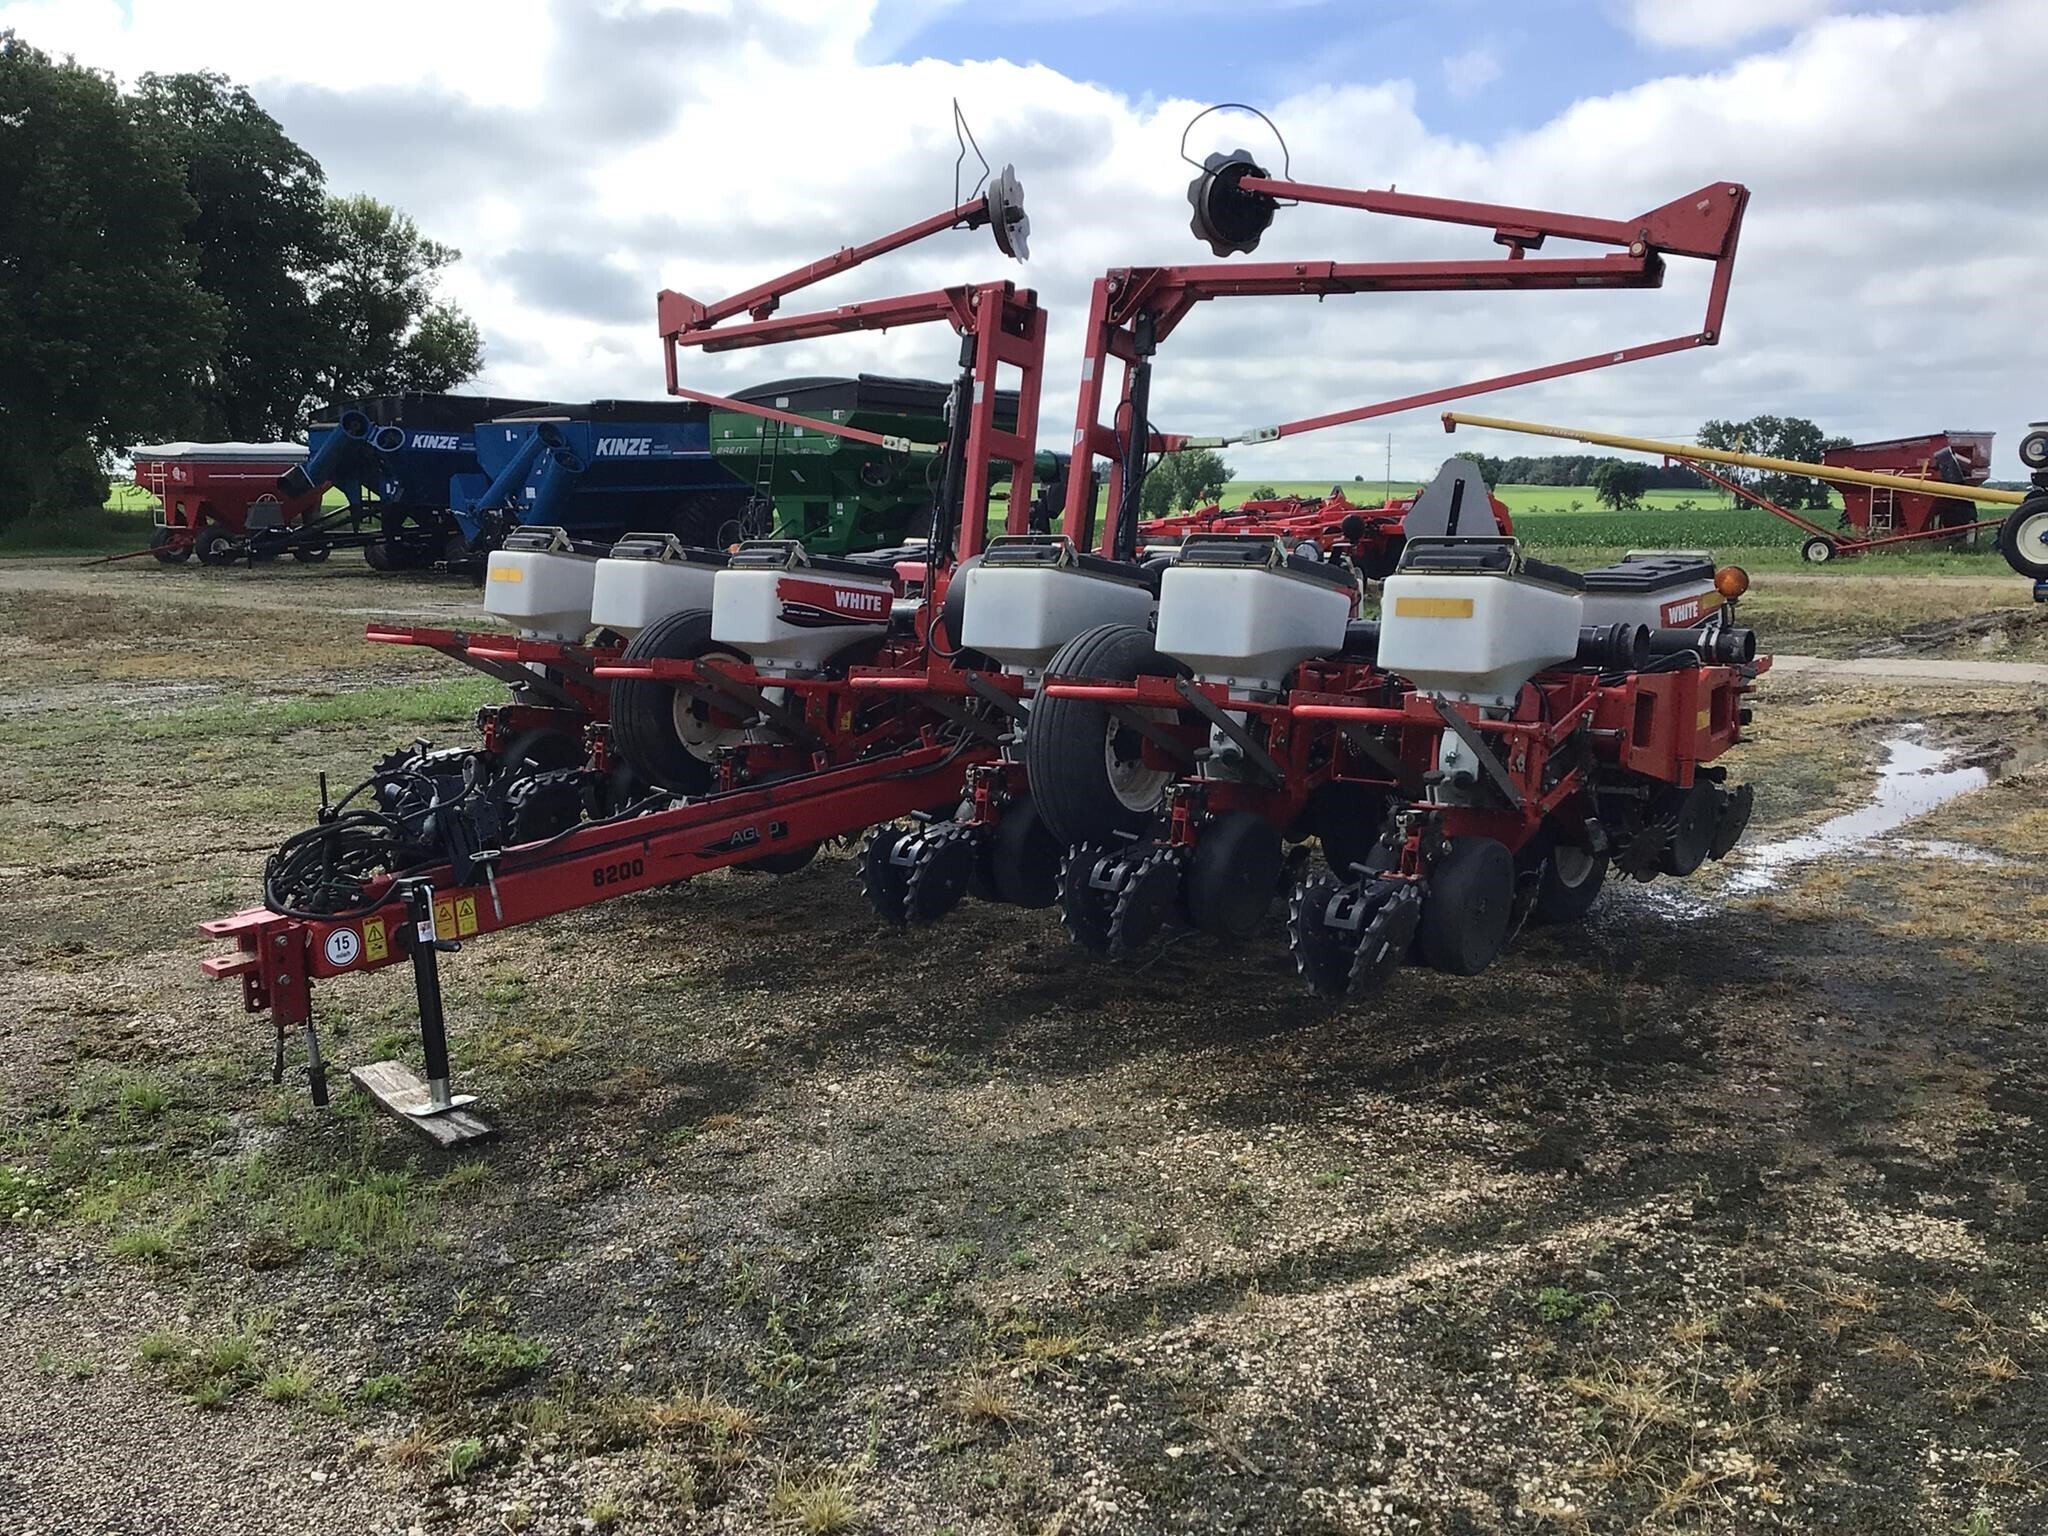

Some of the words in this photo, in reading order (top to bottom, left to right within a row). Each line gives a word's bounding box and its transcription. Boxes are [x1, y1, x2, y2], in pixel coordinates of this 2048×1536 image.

[412, 434, 459, 449] KINZE
[596, 438, 652, 456] KINZE
[834, 590, 882, 612] WHITE
[1668, 600, 1699, 624] WHITE
[592, 858, 644, 887] 8200
[334, 935, 350, 951] 15
